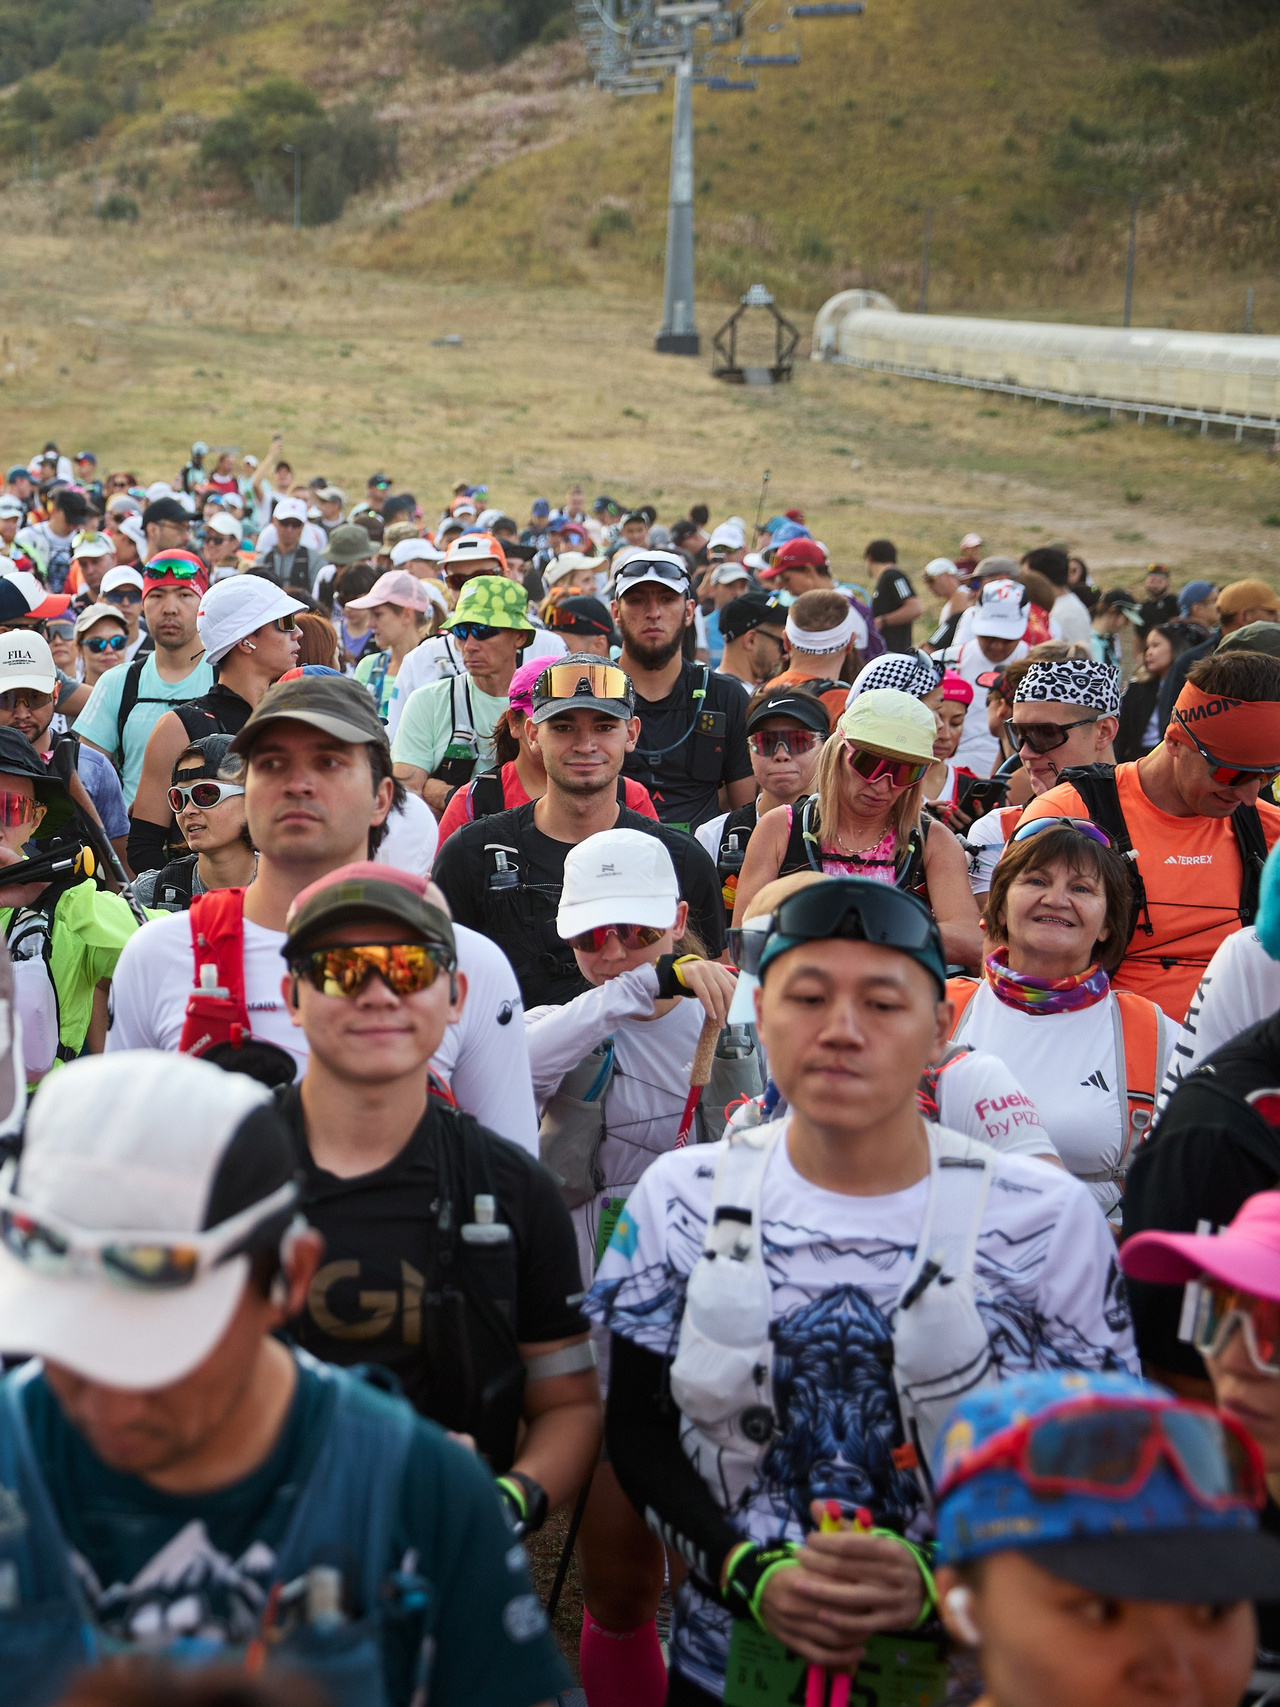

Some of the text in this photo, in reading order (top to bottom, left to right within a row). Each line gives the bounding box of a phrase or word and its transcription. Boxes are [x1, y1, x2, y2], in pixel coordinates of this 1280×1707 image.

[8, 650, 32, 659] FILA
[1177, 854, 1213, 865] TERREX
[985, 1117, 1010, 1138] by
